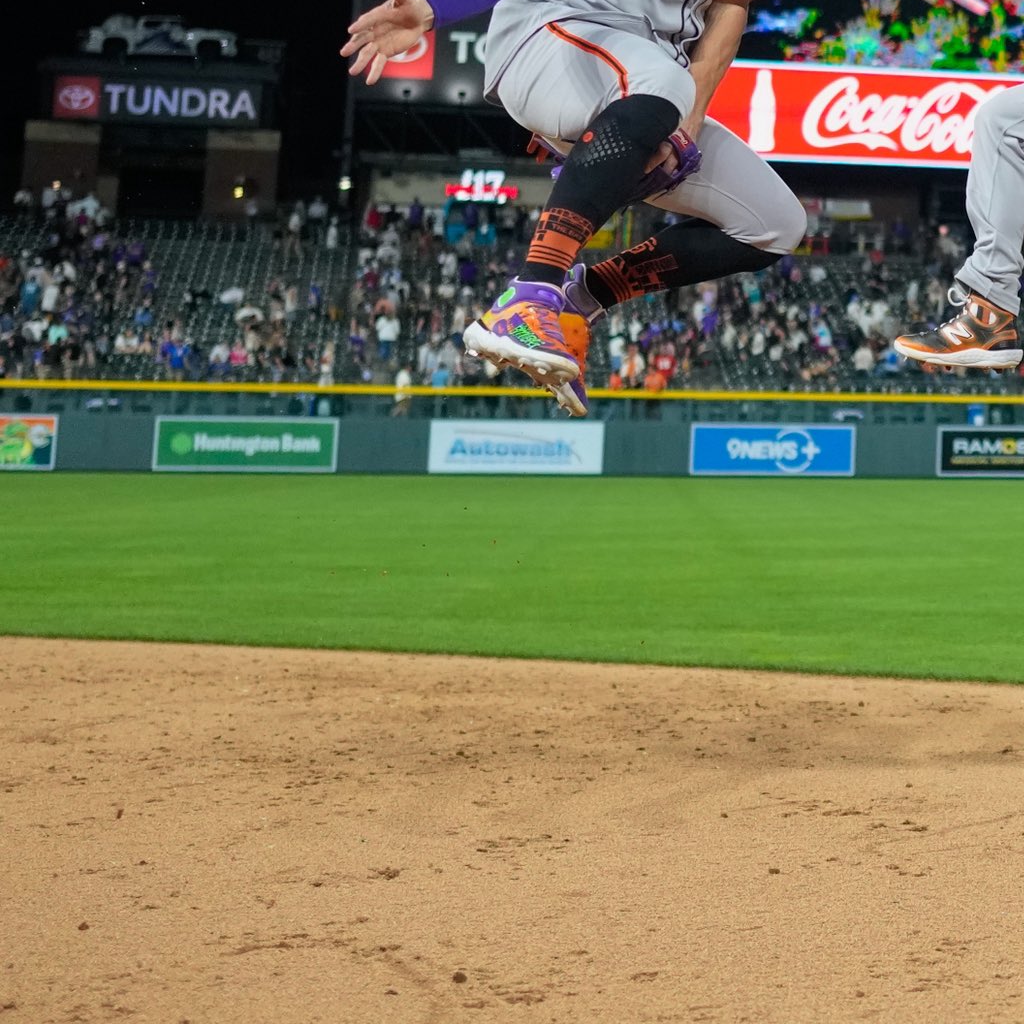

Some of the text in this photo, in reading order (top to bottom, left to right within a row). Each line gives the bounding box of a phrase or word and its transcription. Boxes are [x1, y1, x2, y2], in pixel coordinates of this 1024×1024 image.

[104, 83, 256, 120] TUNDRA
[802, 75, 1006, 154] Coca-Col
[193, 432, 321, 457] Huntington Bank
[449, 438, 571, 457] Autowash
